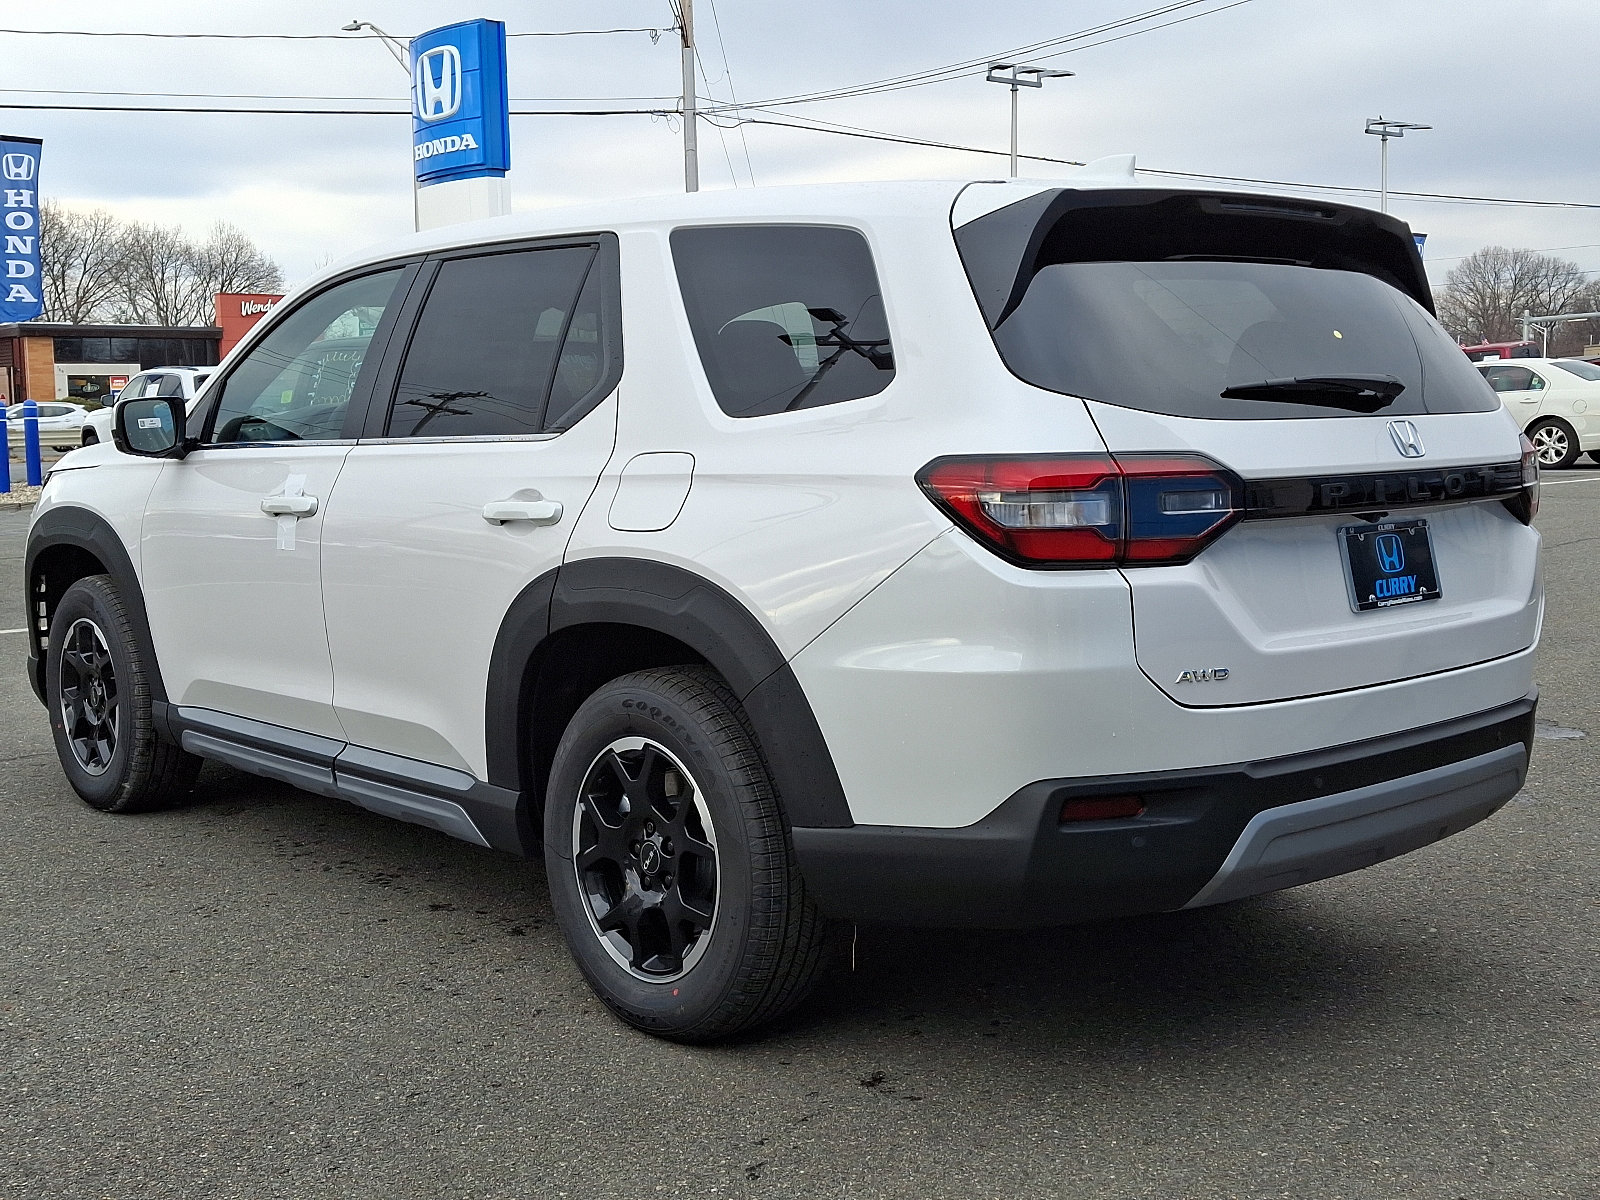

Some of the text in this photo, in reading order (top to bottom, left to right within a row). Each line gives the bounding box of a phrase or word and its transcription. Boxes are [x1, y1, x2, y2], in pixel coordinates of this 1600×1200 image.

[415, 133, 478, 161] HONDA
[4, 189, 38, 303] HONDA
[1321, 470, 1495, 507] PILOT
[1375, 575, 1416, 597] CURRY
[1175, 667, 1229, 684] AWD
